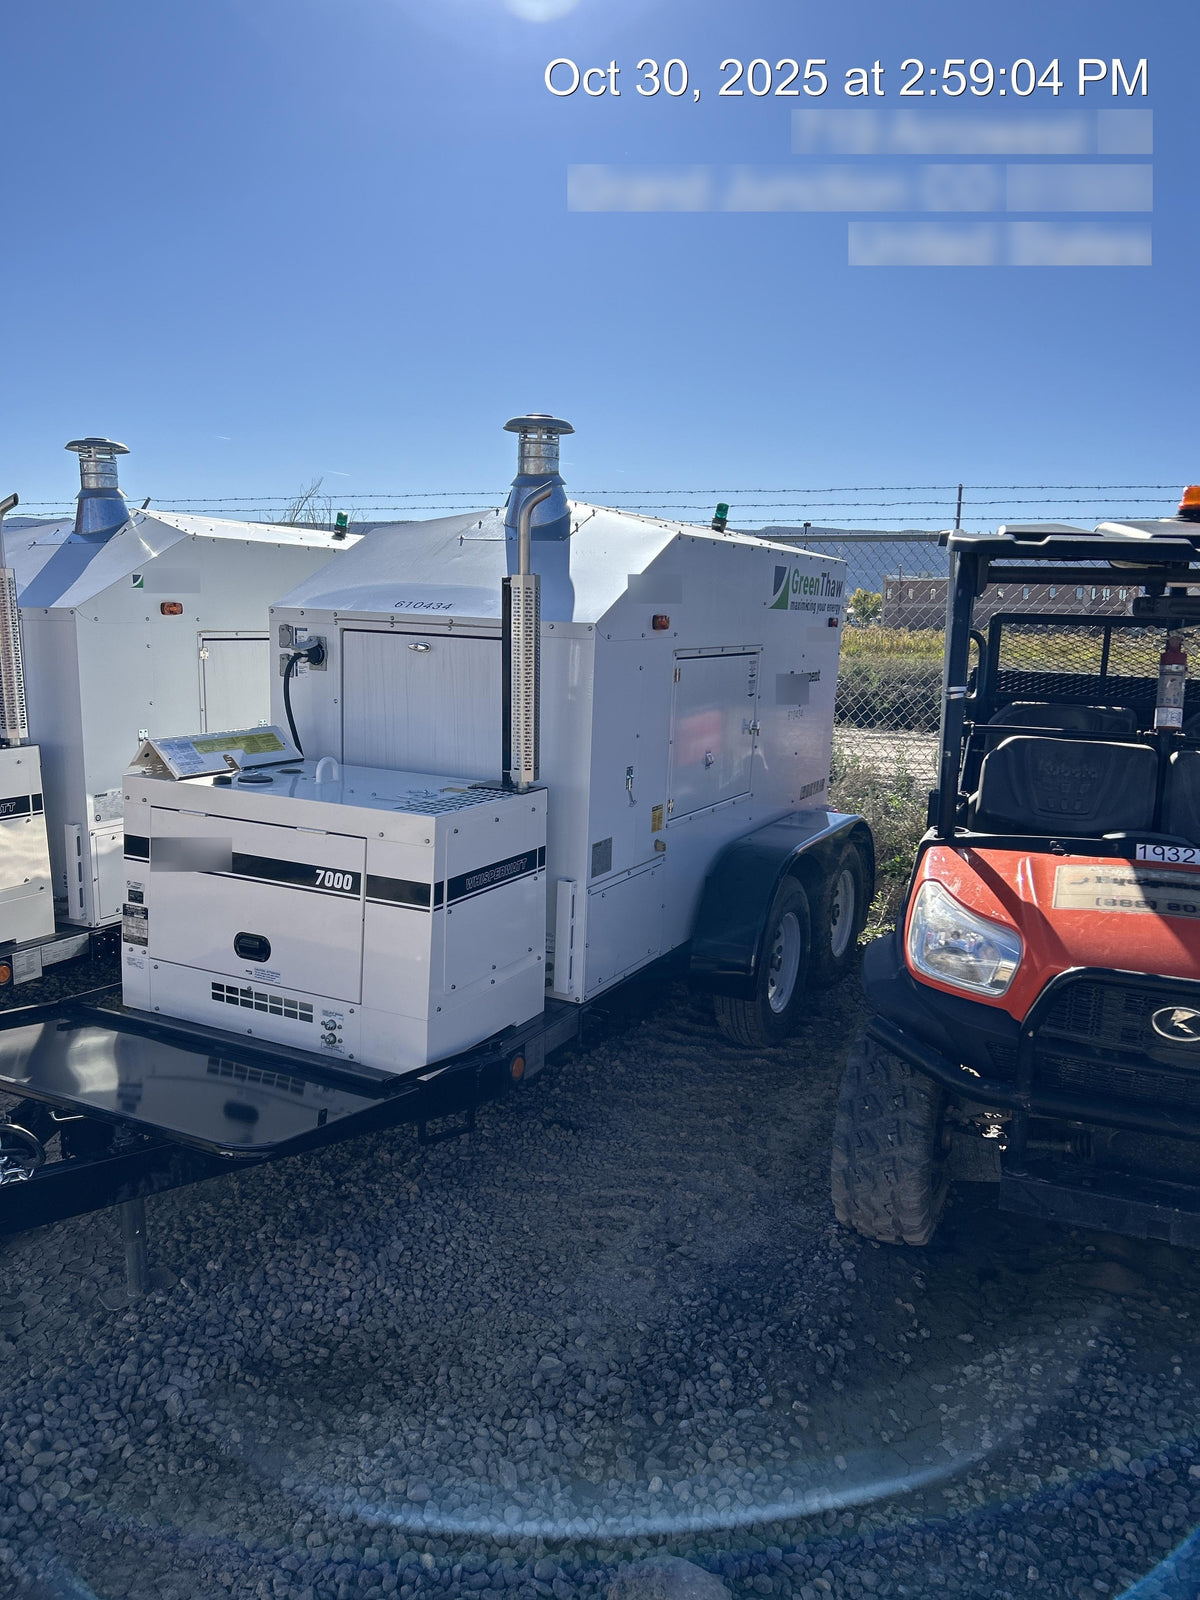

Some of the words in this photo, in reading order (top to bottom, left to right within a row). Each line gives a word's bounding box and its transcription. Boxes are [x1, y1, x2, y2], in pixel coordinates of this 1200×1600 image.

[394, 600, 455, 610] 610434
[1138, 844, 1200, 863] 1932
[315, 869, 353, 891] 7000
[465, 857, 528, 891] WHISPERWATT
